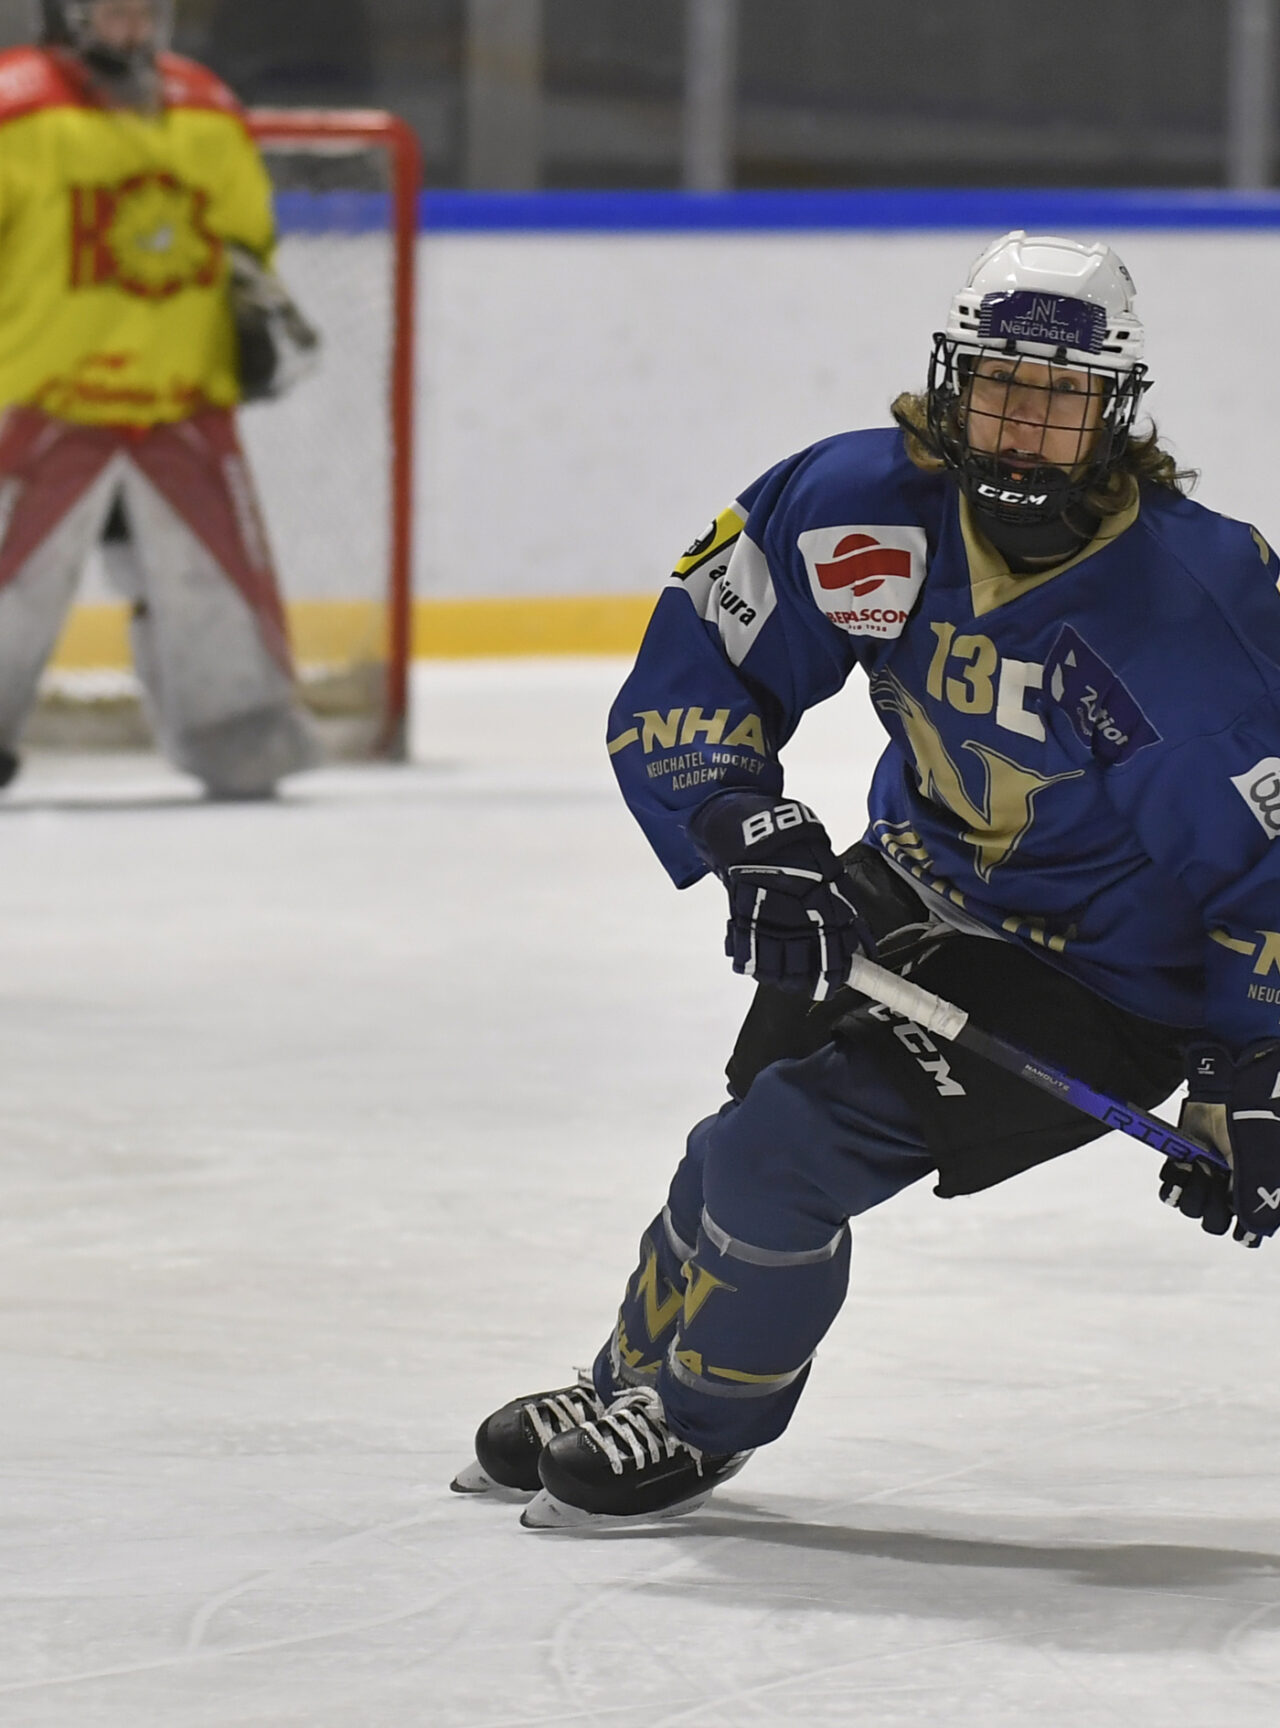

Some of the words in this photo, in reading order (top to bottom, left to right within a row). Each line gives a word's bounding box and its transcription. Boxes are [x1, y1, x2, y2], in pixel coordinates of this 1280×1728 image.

[1000, 318, 1081, 345] Neuchâtel
[977, 483, 1048, 506] CCM
[926, 621, 998, 715] 13
[632, 706, 767, 758] NHA
[646, 751, 706, 780] NEUCHATEL
[711, 751, 766, 776] HOCKEY
[672, 767, 728, 792] ACADEMY
[868, 1002, 968, 1097] CCM
